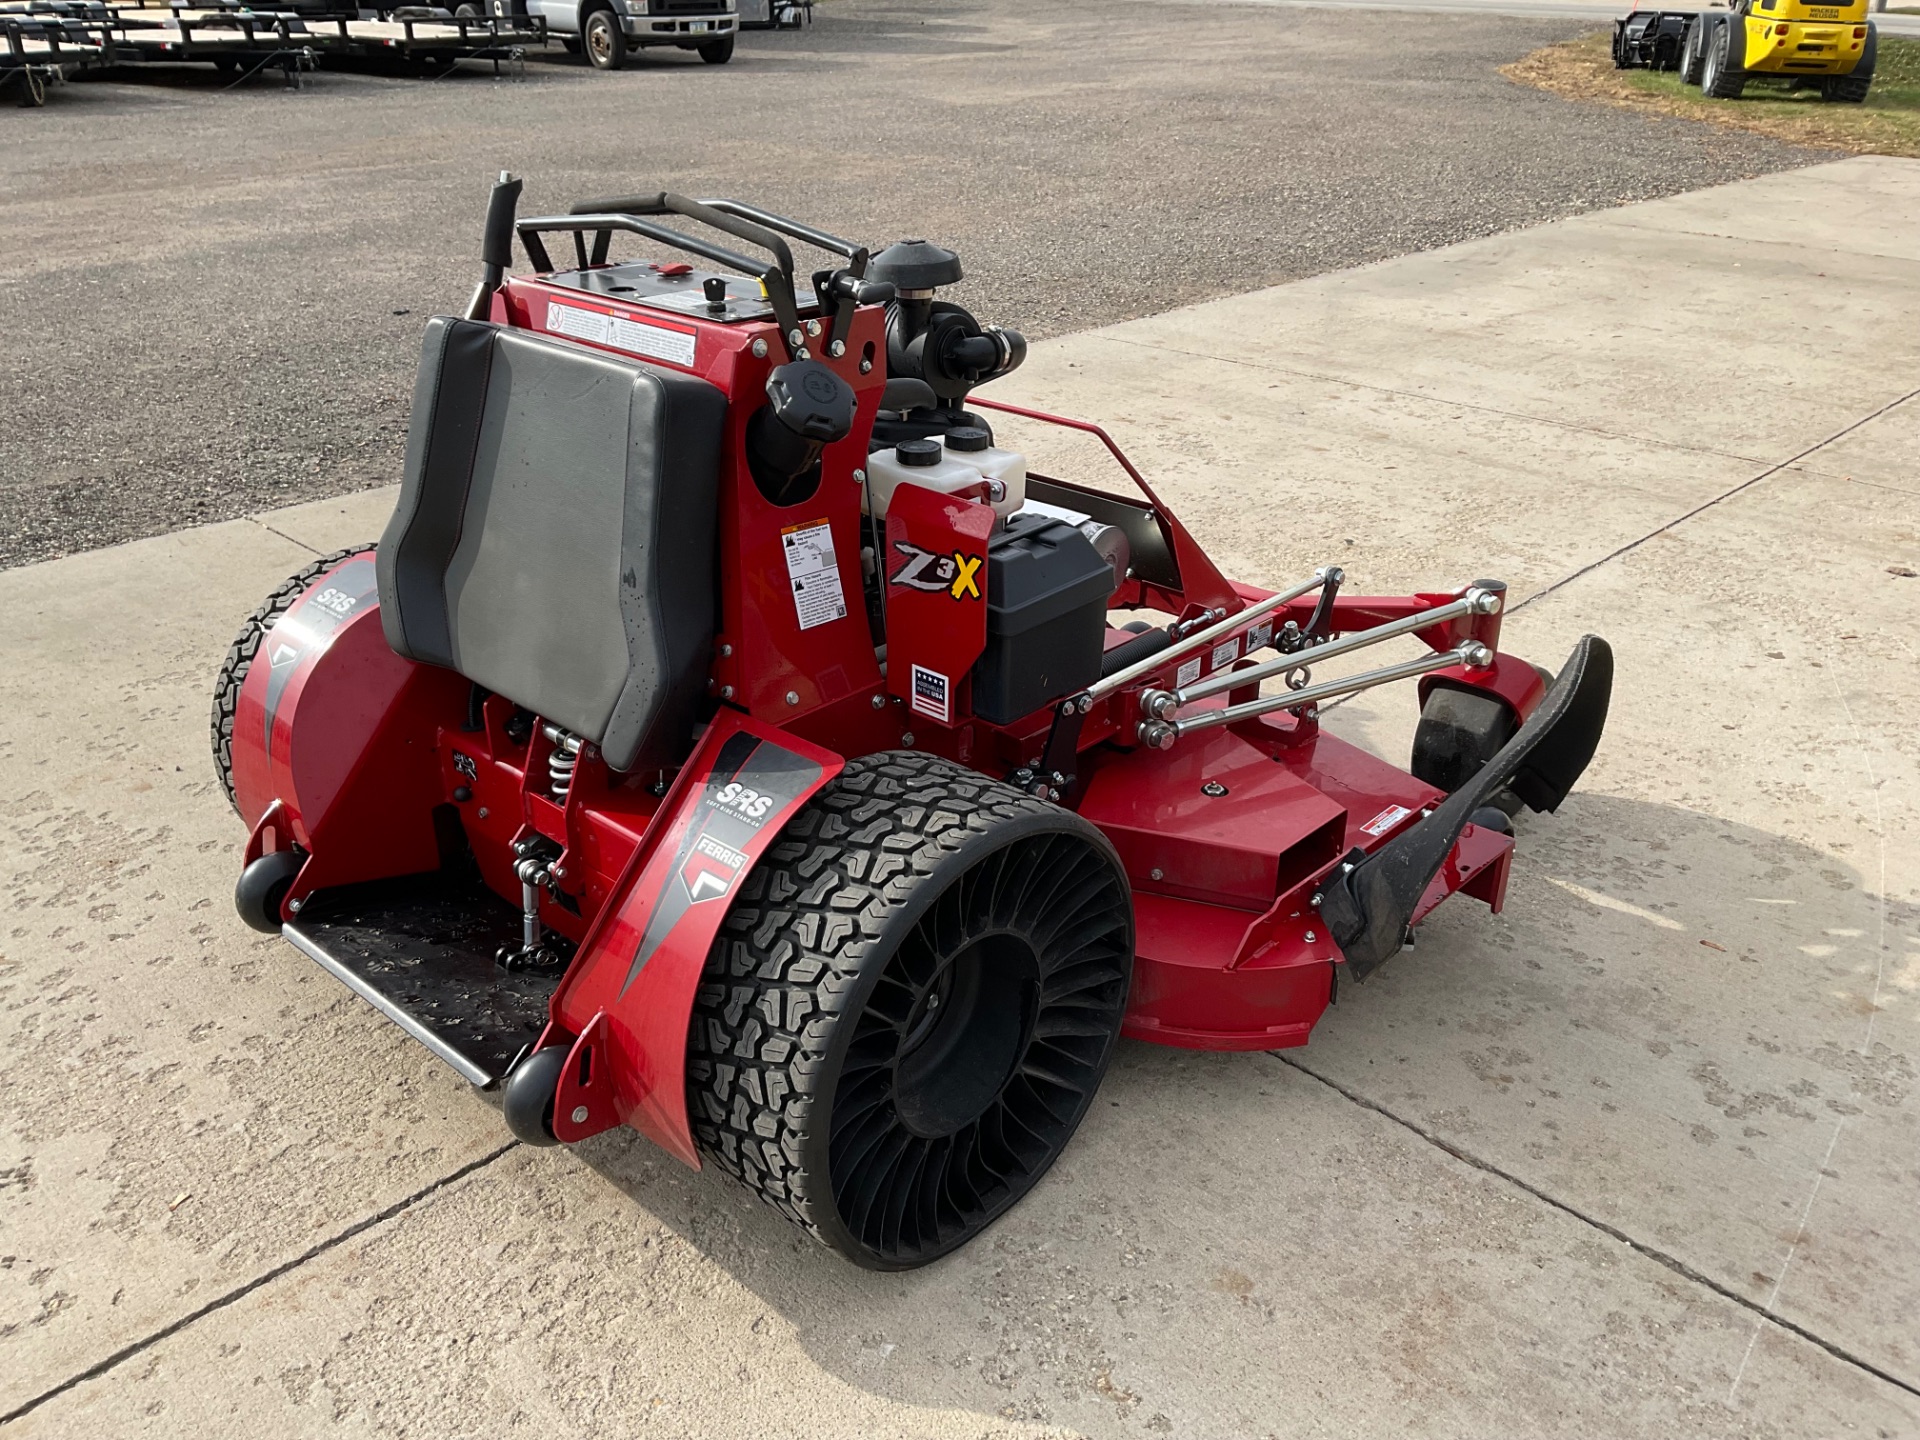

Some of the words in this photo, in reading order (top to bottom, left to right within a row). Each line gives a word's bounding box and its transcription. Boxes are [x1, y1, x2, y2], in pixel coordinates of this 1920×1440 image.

[317, 588, 357, 612] SRS
[917, 680, 944, 693] ASSEMBLED
[922, 687, 931, 695] THE
[931, 691, 944, 700] USA
[706, 799, 720, 809] SOFT
[720, 804, 733, 815] RIDE
[716, 782, 773, 817] SRS
[697, 838, 745, 868] FERRIS
